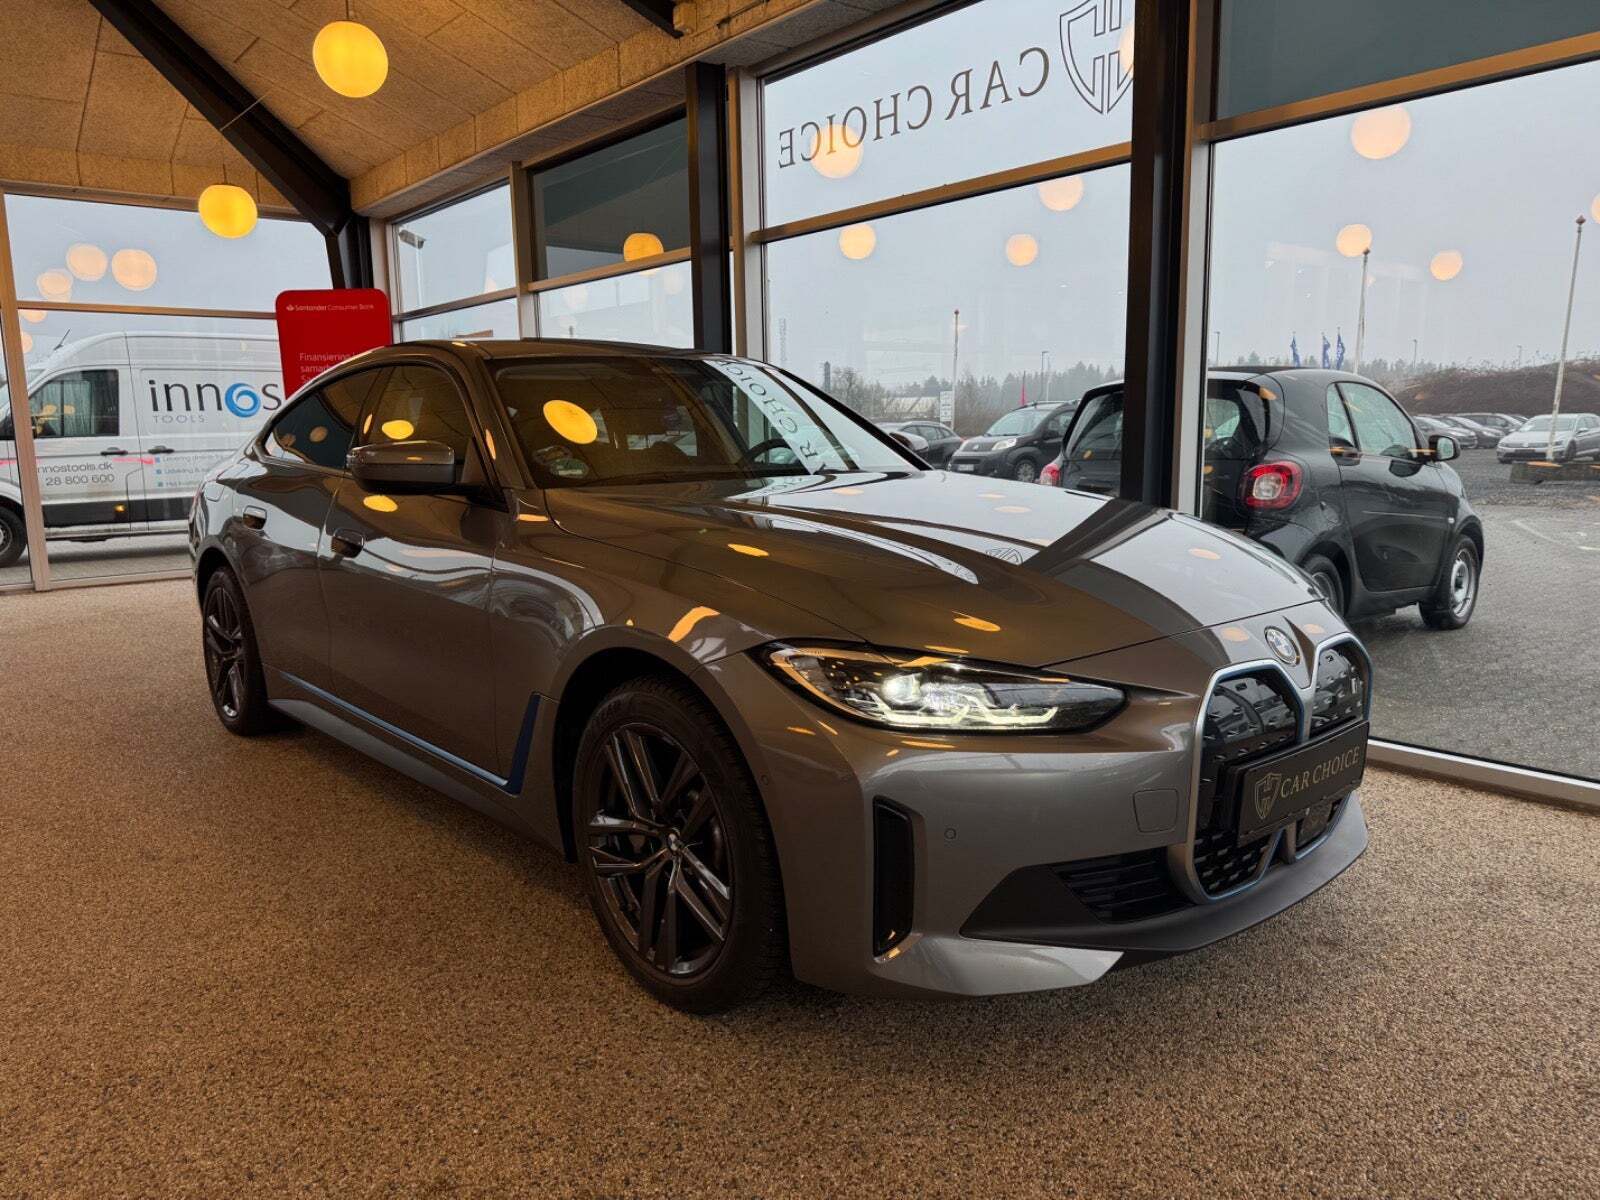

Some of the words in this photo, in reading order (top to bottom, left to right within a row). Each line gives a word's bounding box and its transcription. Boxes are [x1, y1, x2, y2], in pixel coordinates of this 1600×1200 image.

[148, 379, 282, 418] innos
[153, 415, 206, 424] TOOLS
[37, 461, 113, 473] nnostools.dk
[46, 476, 62, 486] 28
[65, 475, 89, 485] 800
[1280, 771, 1309, 798] CAR
[1312, 746, 1360, 784] CHOICE
